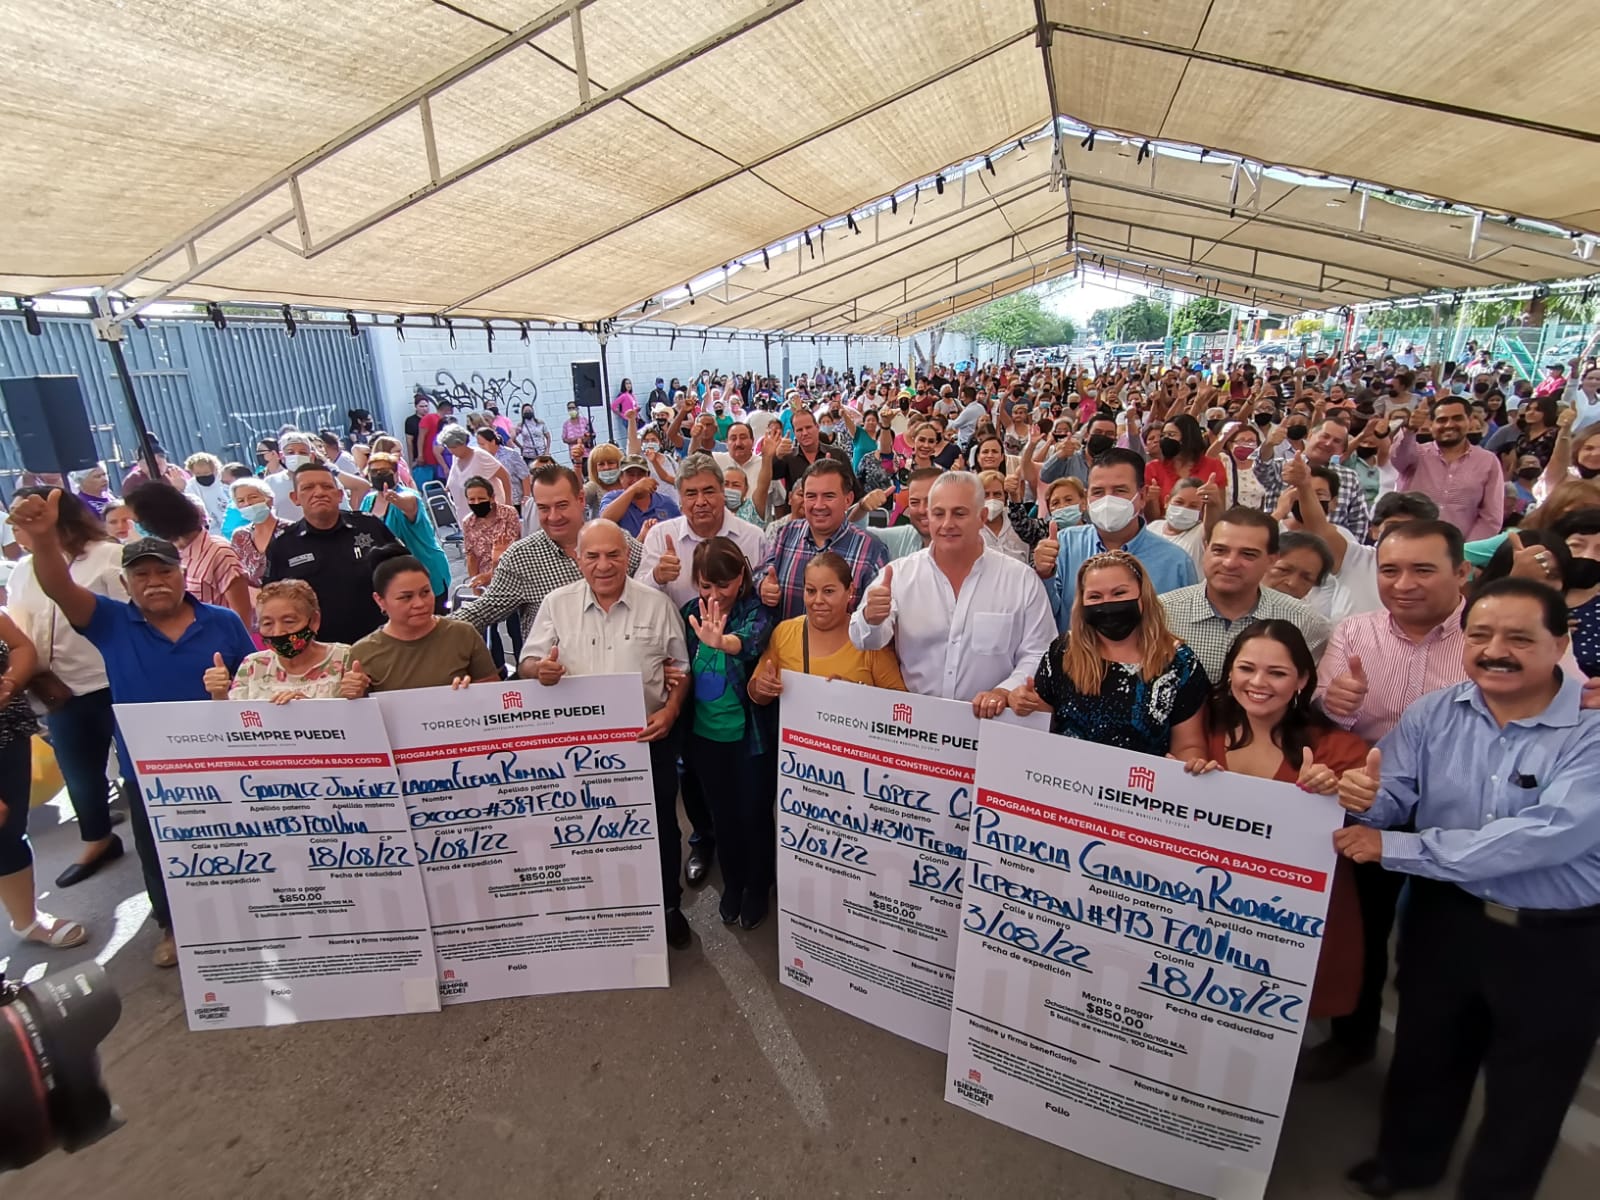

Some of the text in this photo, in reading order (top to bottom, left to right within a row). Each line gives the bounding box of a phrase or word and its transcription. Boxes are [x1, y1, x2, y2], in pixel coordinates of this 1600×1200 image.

[421, 718, 480, 731] TORREÓN
[484, 709, 551, 726] ¡SIEMPRE
[554, 705, 605, 718] PUEDE!
[817, 711, 868, 730] TORREÓN
[871, 721, 938, 744] ¡SIEMPRE
[167, 729, 346, 744] TORREÓN ¡SIEMPRE PUEDE!
[394, 731, 636, 761] PROGRAMA DE MATERIAL DE CONSTRUCCIÓN BAJO COSTO
[207, 760, 248, 768] MATERIAL
[261, 757, 322, 766] CONSTRUCCIÓN
[355, 756, 382, 764] COSTO
[788, 733, 831, 750] PROGRAMA
[831, 744, 842, 753] DE
[843, 747, 881, 761] MATERIAL
[882, 755, 894, 764] DE
[895, 758, 962, 778] CONSTRUCCIÓN
[963, 771, 970, 779] A
[146, 777, 222, 805] MARTHA
[497, 786, 529, 795] Apellido
[530, 783, 560, 792] paterno
[781, 749, 846, 790] JUANA
[864, 768, 932, 810] LÓPEZ
[802, 785, 931, 823] Nombre Apellido paterno
[1025, 770, 1272, 839] TORREÓN ¡SIEMPRE PUEDE!
[550, 815, 652, 845] 18/08/22
[781, 825, 869, 865] 3/08/22
[807, 822, 949, 866] Calle número Colonia
[986, 795, 1041, 817] PROGRAMA
[1043, 811, 1056, 820] DE
[1058, 814, 1110, 835] MATERIAL
[1112, 829, 1126, 839] DE
[1128, 833, 1219, 863] CONSTRUCCIÓN
[1221, 857, 1230, 866] A
[1233, 860, 1267, 874] BAJO
[1270, 868, 1313, 884] COSTO
[168, 841, 414, 877] 3/08/22 18/08/22
[463, 858, 503, 869] expedición
[571, 848, 593, 856] Fecha
[605, 844, 642, 853] caducidad
[544, 863, 566, 872] pagar
[973, 807, 1070, 868] PATRICIA
[1079, 841, 1203, 912] GANDARA
[519, 871, 562, 882] $850.00
[794, 855, 814, 866] Fecha
[825, 864, 861, 881] expedición
[930, 896, 952, 908] Fecha
[968, 858, 1083, 922] TEPEXPAN
[278, 893, 322, 903] $850.00
[869, 891, 922, 911] Monto pagar
[872, 900, 916, 919] $850.00
[1000, 857, 1305, 949] Nombre Apellido paterno Apellido materno
[1002, 902, 1026, 916] Calle
[1027, 912, 1034, 920] y
[1036, 914, 1071, 930] número
[1154, 950, 1194, 968] Colonia
[964, 904, 1090, 967] 3/08/22
[1142, 962, 1303, 1023] 18/08/22
[850, 983, 868, 994] Folio
[982, 941, 1274, 1040] Fecha de expedición Fecha de caducidad
[1081, 990, 1153, 1022] Monto a pagar
[1086, 1002, 1144, 1030] $850.00
[1056, 1013, 1080, 1026] bultos
[1081, 1021, 1091, 1029] de
[1093, 1025, 1129, 1043] cemento,
[1131, 1039, 1145, 1048] 100
[1147, 1044, 1174, 1058] blocks
[969, 1019, 998, 1035] Nombre
[1007, 1034, 1028, 1047] firma
[1030, 1041, 1077, 1065] beneficiario
[1134, 1080, 1170, 1096] Nombre
[1172, 1092, 1179, 1101] y
[1181, 1093, 1205, 1106] firma
[1207, 1103, 1264, 1125] responsable
[1045, 1102, 1070, 1117] Folio
